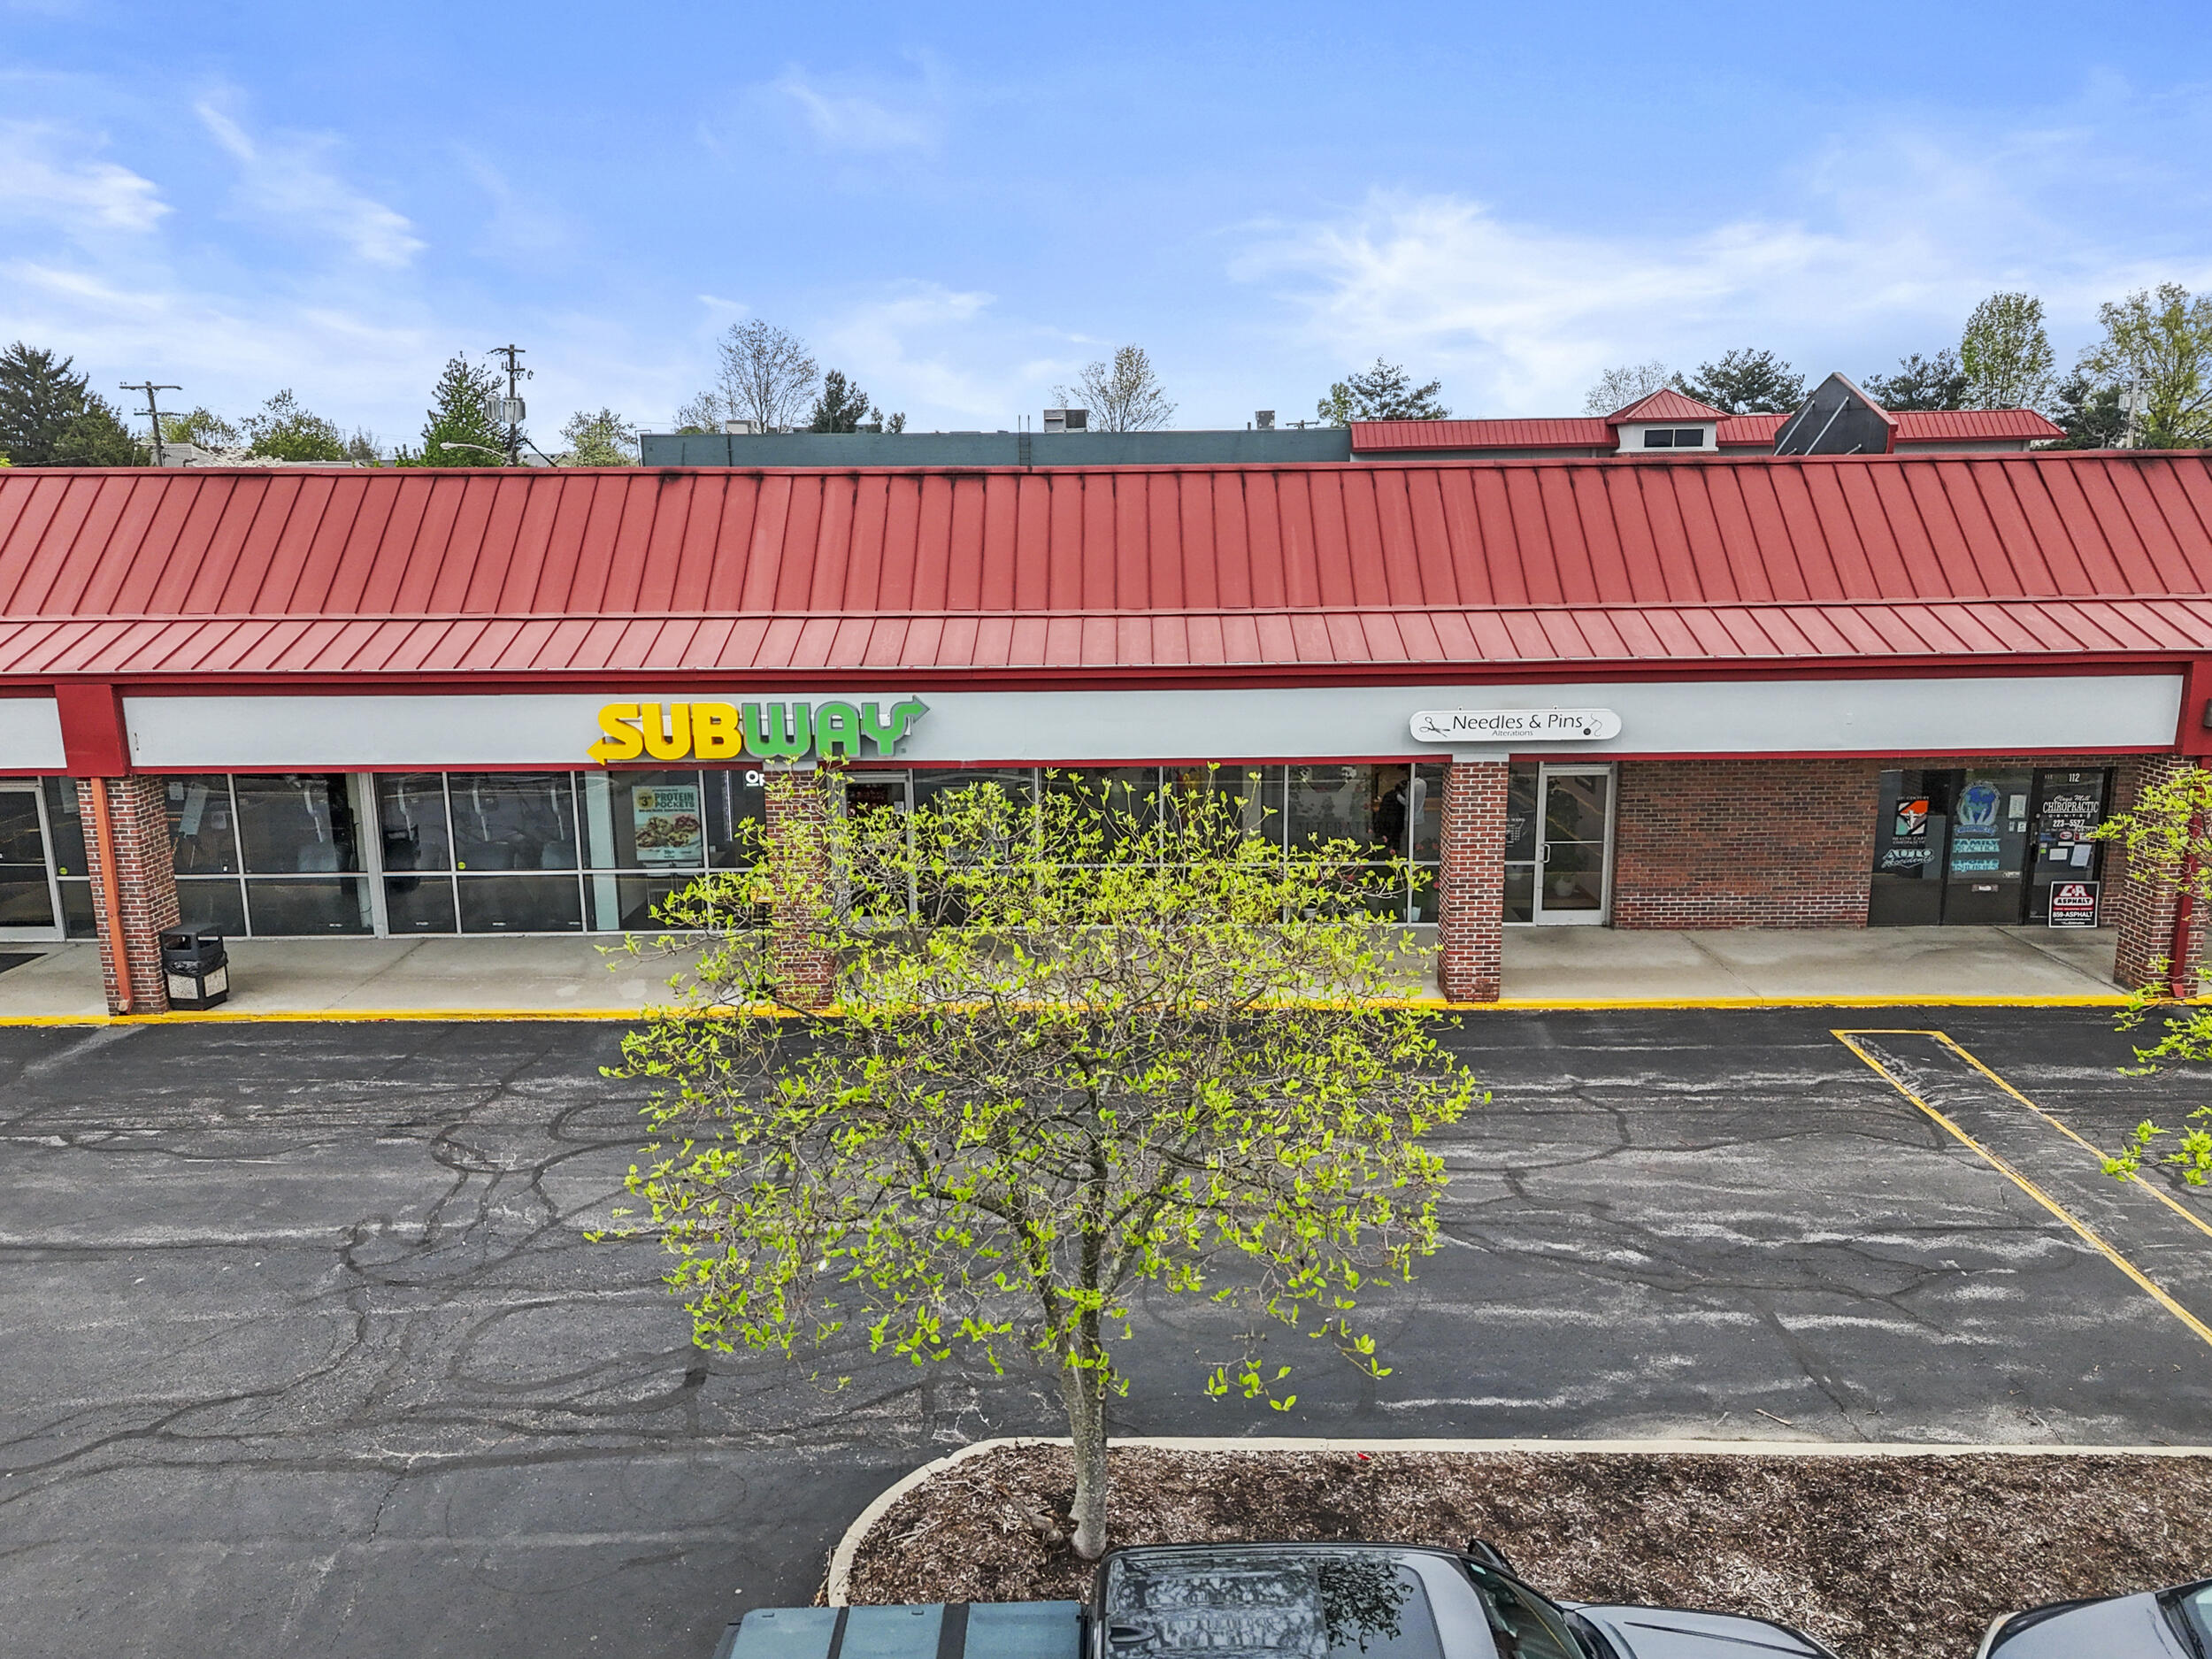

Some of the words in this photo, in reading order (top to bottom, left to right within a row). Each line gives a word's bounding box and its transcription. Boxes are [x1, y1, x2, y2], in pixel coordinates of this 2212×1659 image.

[1453, 714, 1523, 730] Needles
[1529, 714, 1541, 729] &
[1548, 714, 1583, 729] Pins
[587, 695, 930, 765] SUBWAY
[745, 770, 764, 787] Op
[2069, 772, 2080, 782] 112
[655, 792, 694, 802] PROTEIN
[2042, 801, 2100, 813] CHIROPRACTIC
[1883, 849, 1933, 859] AUTO
